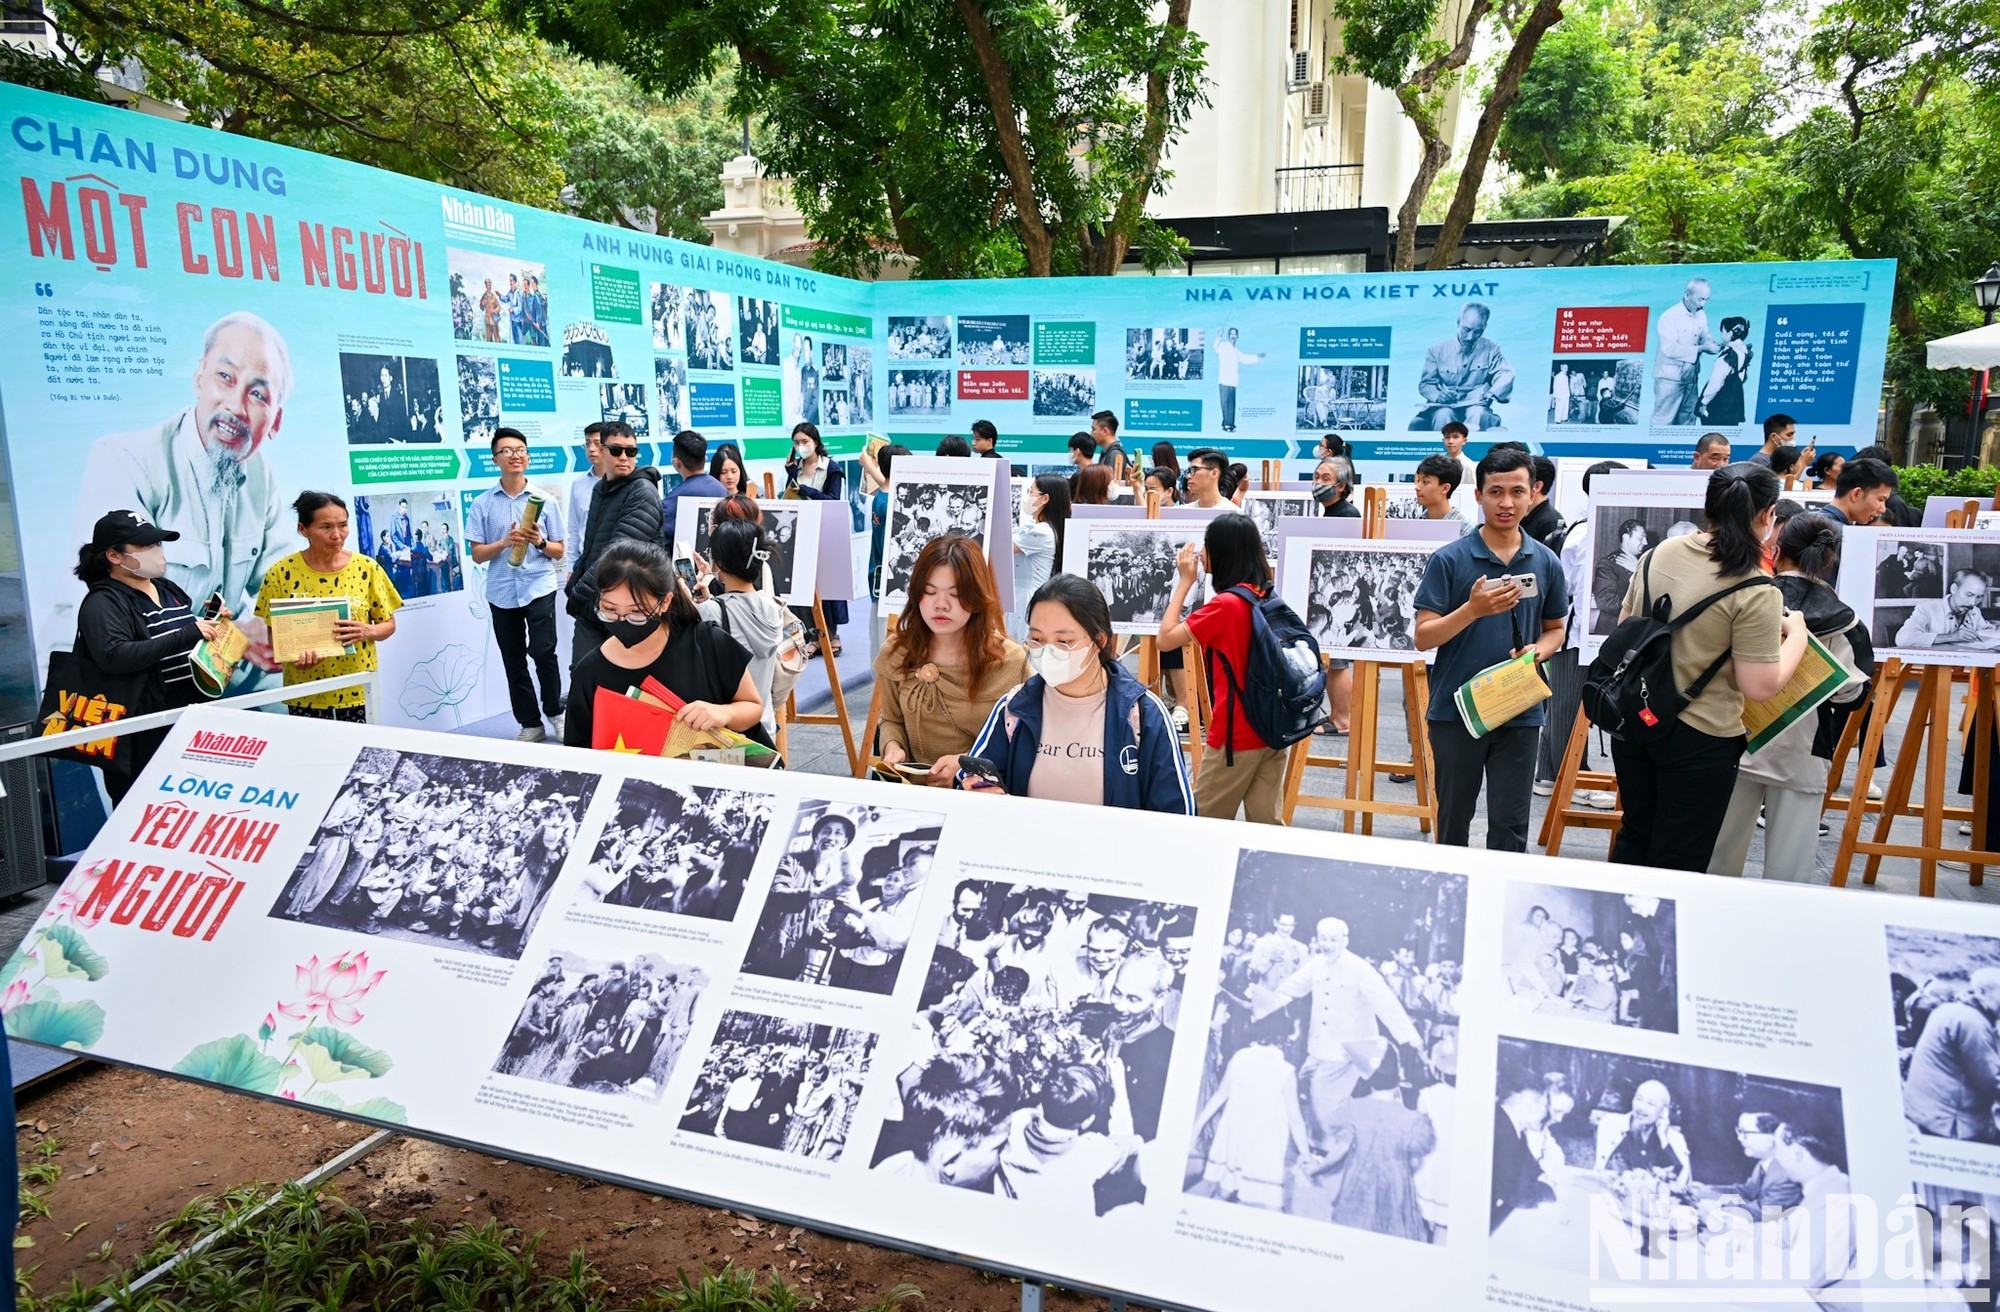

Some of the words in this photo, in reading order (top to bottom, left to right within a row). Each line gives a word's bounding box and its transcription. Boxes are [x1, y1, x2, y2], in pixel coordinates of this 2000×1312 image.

[173, 147, 287, 196] DUNG
[442, 195, 484, 228] Nhân
[484, 205, 515, 234] Dân
[20, 173, 148, 272] MỘT
[176, 201, 281, 282] CON
[298, 220, 428, 300] NGƯỜI
[583, 233, 620, 254] ANH
[189, 731, 235, 751] Nhân
[231, 736, 268, 756] Dân
[1036, 742, 1061, 756] ear
[1066, 742, 1104, 758] Crus
[159, 771, 234, 800] LÒNG
[129, 800, 199, 849] YÊU
[189, 809, 280, 863] KÍNH
[77, 859, 247, 942] NGƯỜI
